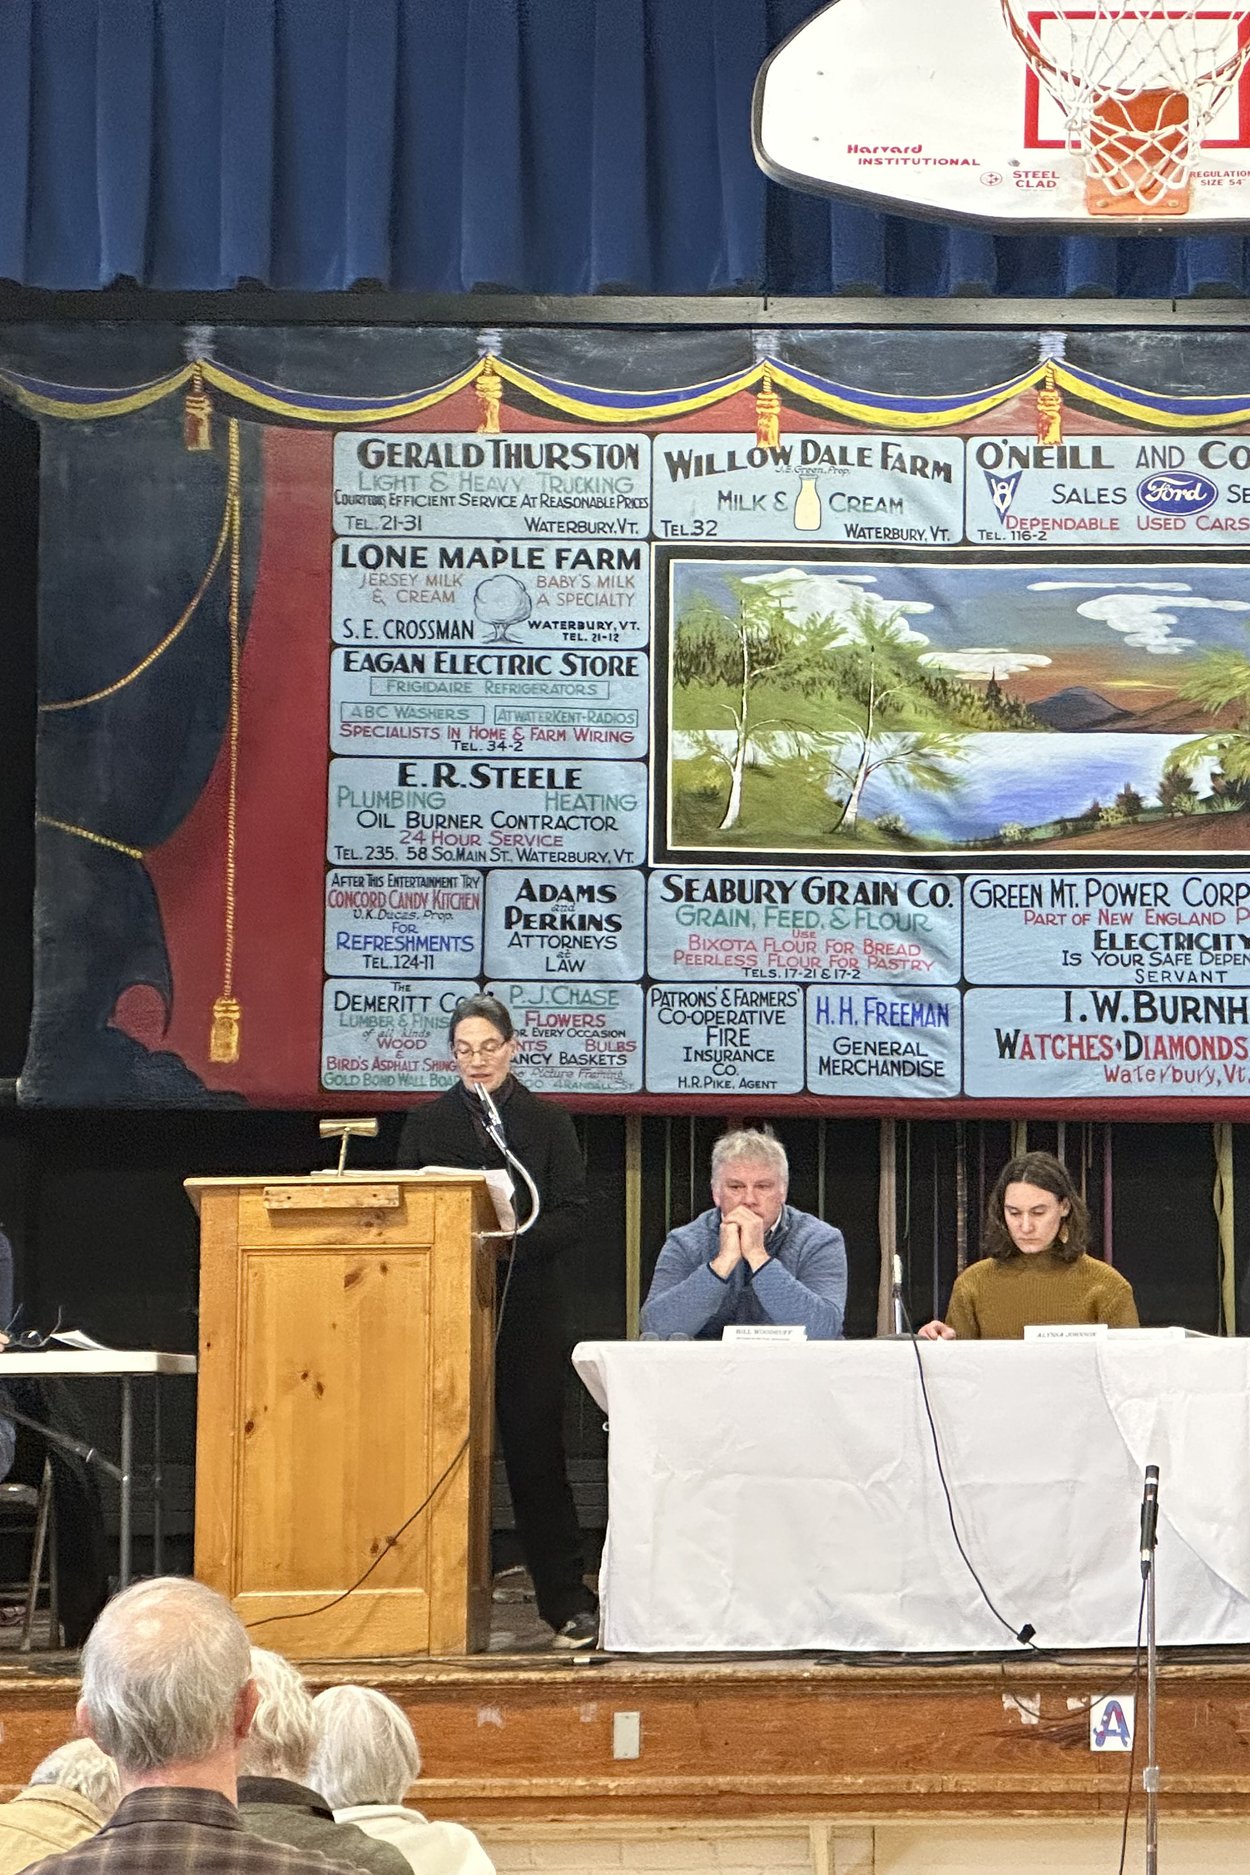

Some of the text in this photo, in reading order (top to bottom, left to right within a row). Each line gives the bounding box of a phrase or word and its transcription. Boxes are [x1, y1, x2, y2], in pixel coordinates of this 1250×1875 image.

[848, 144, 922, 154] Harvard
[1016, 180, 1056, 188] CLAD
[357, 438, 639, 470] GERALD THURSTON
[664, 440, 952, 483] WILLOW DALE FARM
[976, 439, 1114, 470] O'NEILL
[1136, 446, 1185, 468] AND
[359, 472, 634, 494] LIGHT & HEAVY TRUCKING
[1145, 477, 1208, 501] Ford
[829, 493, 903, 514] CREAM
[1052, 484, 1127, 505] SALES
[1006, 515, 1119, 531] DEPENDABLE
[1137, 516, 1186, 531] USED
[1196, 516, 1250, 531] CARS
[341, 544, 640, 570] LONE MAPLE FARM
[359, 573, 463, 588] JERSEY MILK
[536, 575, 635, 588] BABY'S MILK
[396, 590, 455, 604] CREAM
[537, 593, 635, 607] A SPECIALTY
[384, 620, 474, 640] CROSSMAN
[343, 650, 639, 677] EAGAN ELECTRIC STORE
[387, 680, 597, 696] FRIGIDAIRE REFRIGERATORS
[351, 706, 469, 721] ABC WASHERS
[451, 740, 523, 752] TEL. 34-2
[337, 785, 637, 813] PLUMBING HEATING
[356, 810, 618, 831] OIL BURNER CONTRACTOR
[515, 878, 618, 903] ADAMS
[661, 874, 953, 908] SEABURY GRAIN CO.
[970, 878, 1042, 909] GREEN
[1051, 879, 1079, 909] MT.
[1086, 877, 1169, 907] POWER
[551, 904, 575, 913] and
[505, 906, 622, 932] PERKINS
[337, 932, 474, 952] REFRESHMENTS
[507, 934, 617, 950] ATTORNEYS
[792, 930, 816, 939] USE
[688, 934, 921, 957] BIXOTA FLOUR FOR BREAD
[546, 958, 585, 973] LAW
[1062, 951, 1082, 965] IS
[1091, 952, 1144, 967] YOUR
[1149, 951, 1192, 966] SAFE
[1135, 969, 1228, 983] SERVANT
[391, 982, 411, 993] THE
[525, 1012, 606, 1027] FLOWERS
[658, 1007, 785, 1025] CO-OPERATIVE
[864, 997, 949, 1027] FREEMAN
[377, 1038, 427, 1049] WOOD
[585, 1040, 637, 1051] BULBS
[706, 1026, 750, 1047] FIRE
[683, 1046, 774, 1062] INSURANCE
[833, 1037, 928, 1057] GENERAL
[818, 1056, 945, 1078] MERCHANDISE
[1093, 1700, 1131, 1749] A
